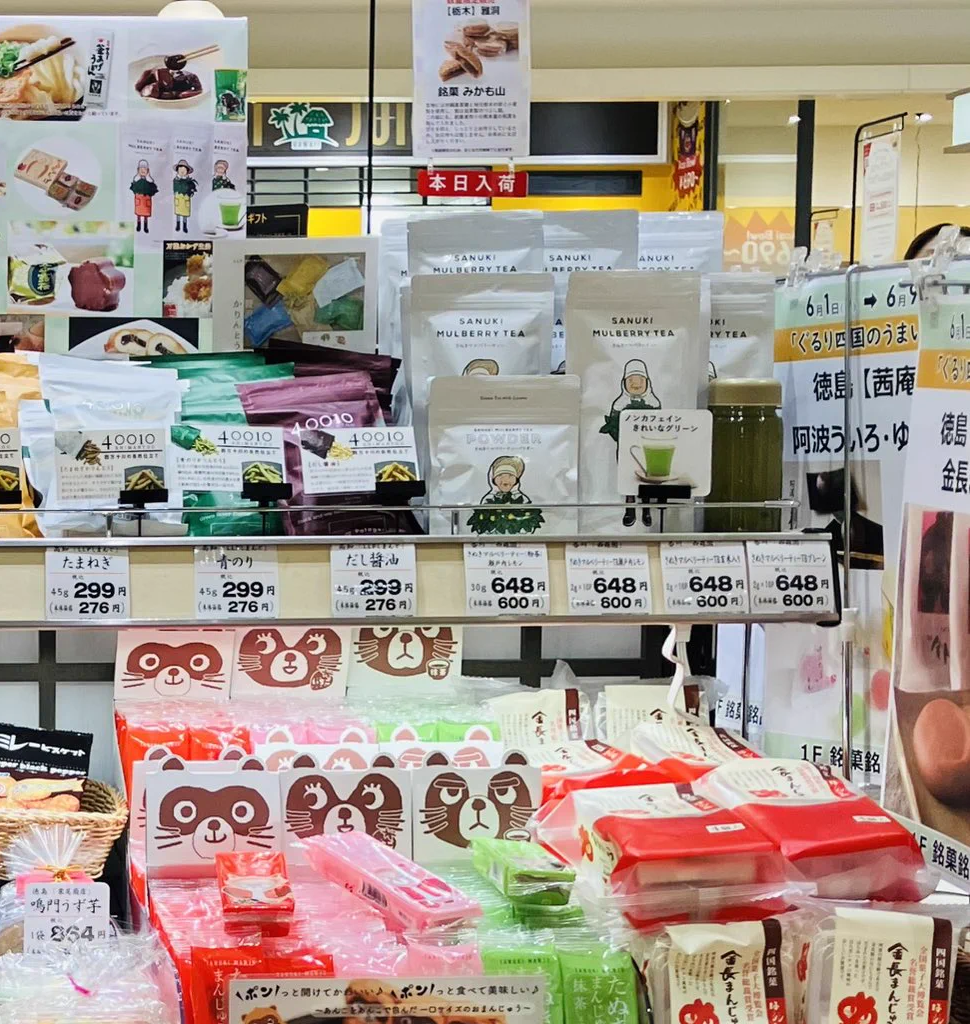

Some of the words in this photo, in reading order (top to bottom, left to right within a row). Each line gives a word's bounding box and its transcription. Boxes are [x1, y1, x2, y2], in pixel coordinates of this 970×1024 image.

[447, 6, 476, 16] 【栃木】
[438, 87, 459, 97] 銘菓
[462, 87, 506, 97] みかも山
[428, 174, 516, 193] 本日入荷
[454, 254, 498, 262] SANUKI
[549, 254, 592, 262] SANUKI
[638, 254, 675, 262] ANUKI
[433, 266, 491, 274] MULBERRY
[495, 265, 518, 273] TEA
[233, 300, 242, 350] かりんとう
[458, 317, 503, 326] SANUKI
[611, 317, 654, 325] SANUKI
[436, 330, 499, 338] MULBERRY
[503, 329, 526, 338] TEA
[592, 329, 650, 338] MULBERRY
[653, 329, 675, 337] TEA
[725, 330, 748, 338] TEA
[813, 369, 854, 402] 徳島
[291, 411, 354, 436] 40010
[624, 414, 682, 424] ノンカフェイン
[632, 424, 699, 434] きれいなグリーン
[940, 411, 968, 448] 徳島
[102, 433, 156, 450] 40010
[218, 430, 273, 445] 40010
[349, 431, 405, 447] 40010
[466, 434, 542, 445] POWDER
[63, 555, 112, 570] たまねぎ
[217, 555, 254, 570] 青のり
[346, 552, 400, 568] だし醤油
[800, 744, 822, 763] 1F
[31, 898, 102, 914] 鳴門うず芋
[766, 948, 778, 987] 四国銘菓
[934, 948, 946, 989] 四国銘菓
